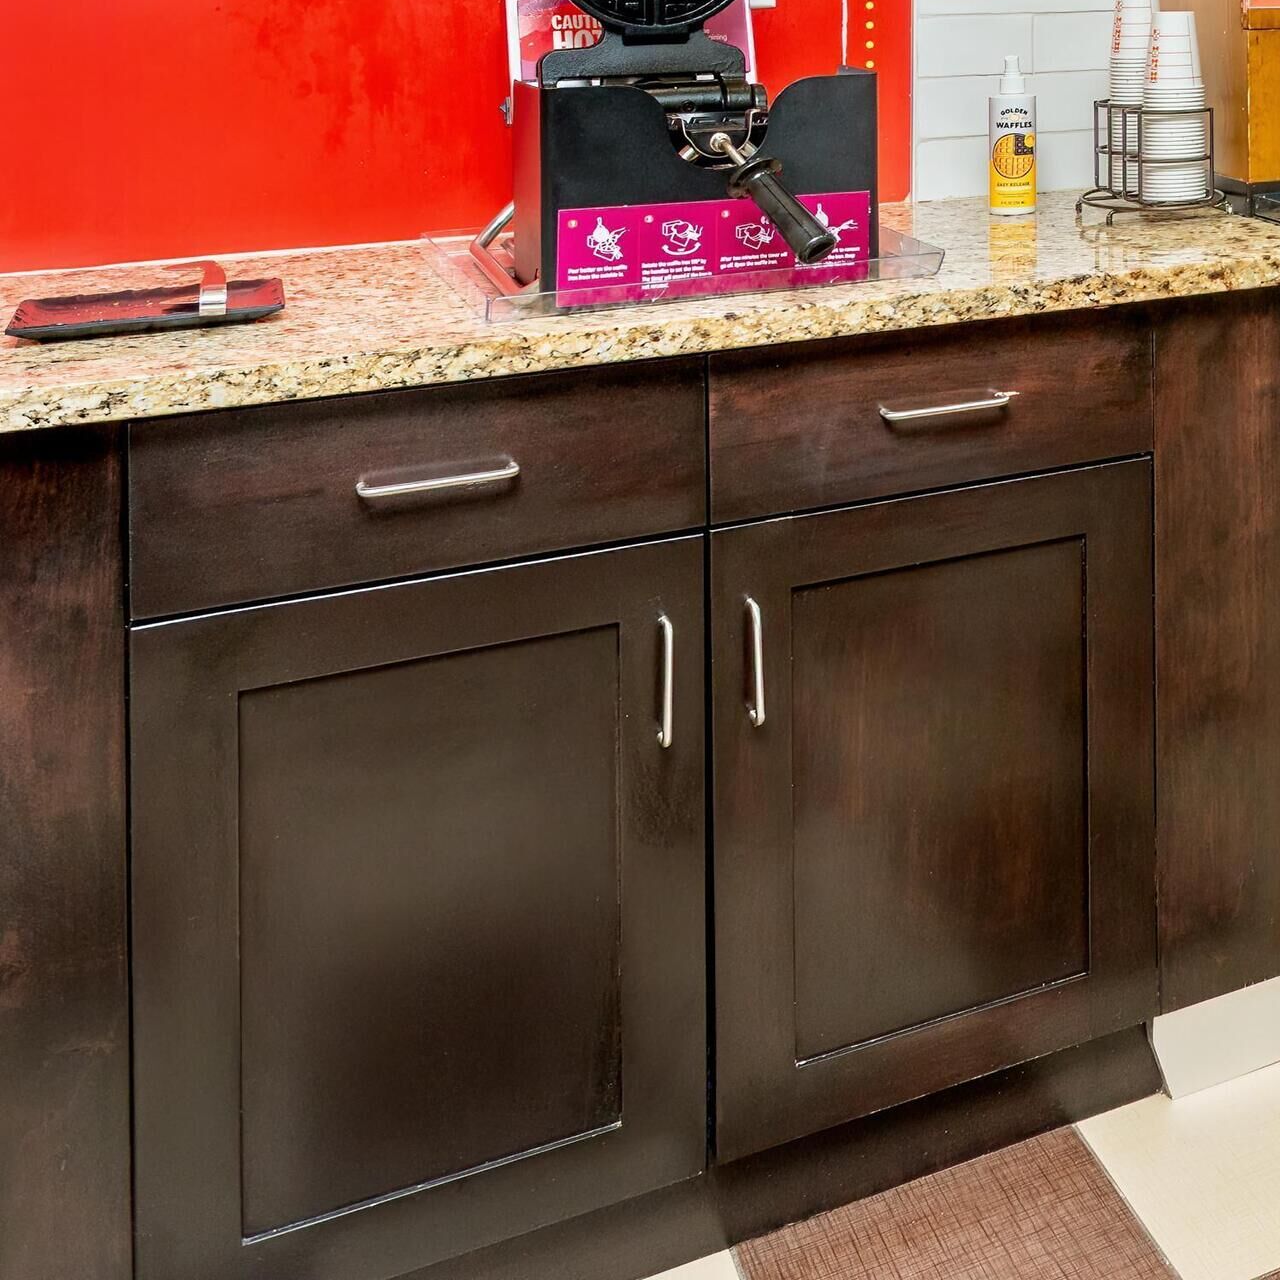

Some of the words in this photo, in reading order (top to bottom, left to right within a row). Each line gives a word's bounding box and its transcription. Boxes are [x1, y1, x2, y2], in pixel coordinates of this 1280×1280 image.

[551, 14, 602, 29] CAUTI
[1000, 108, 1028, 116] GOLDEN
[996, 121, 1032, 129] WAFFLES
